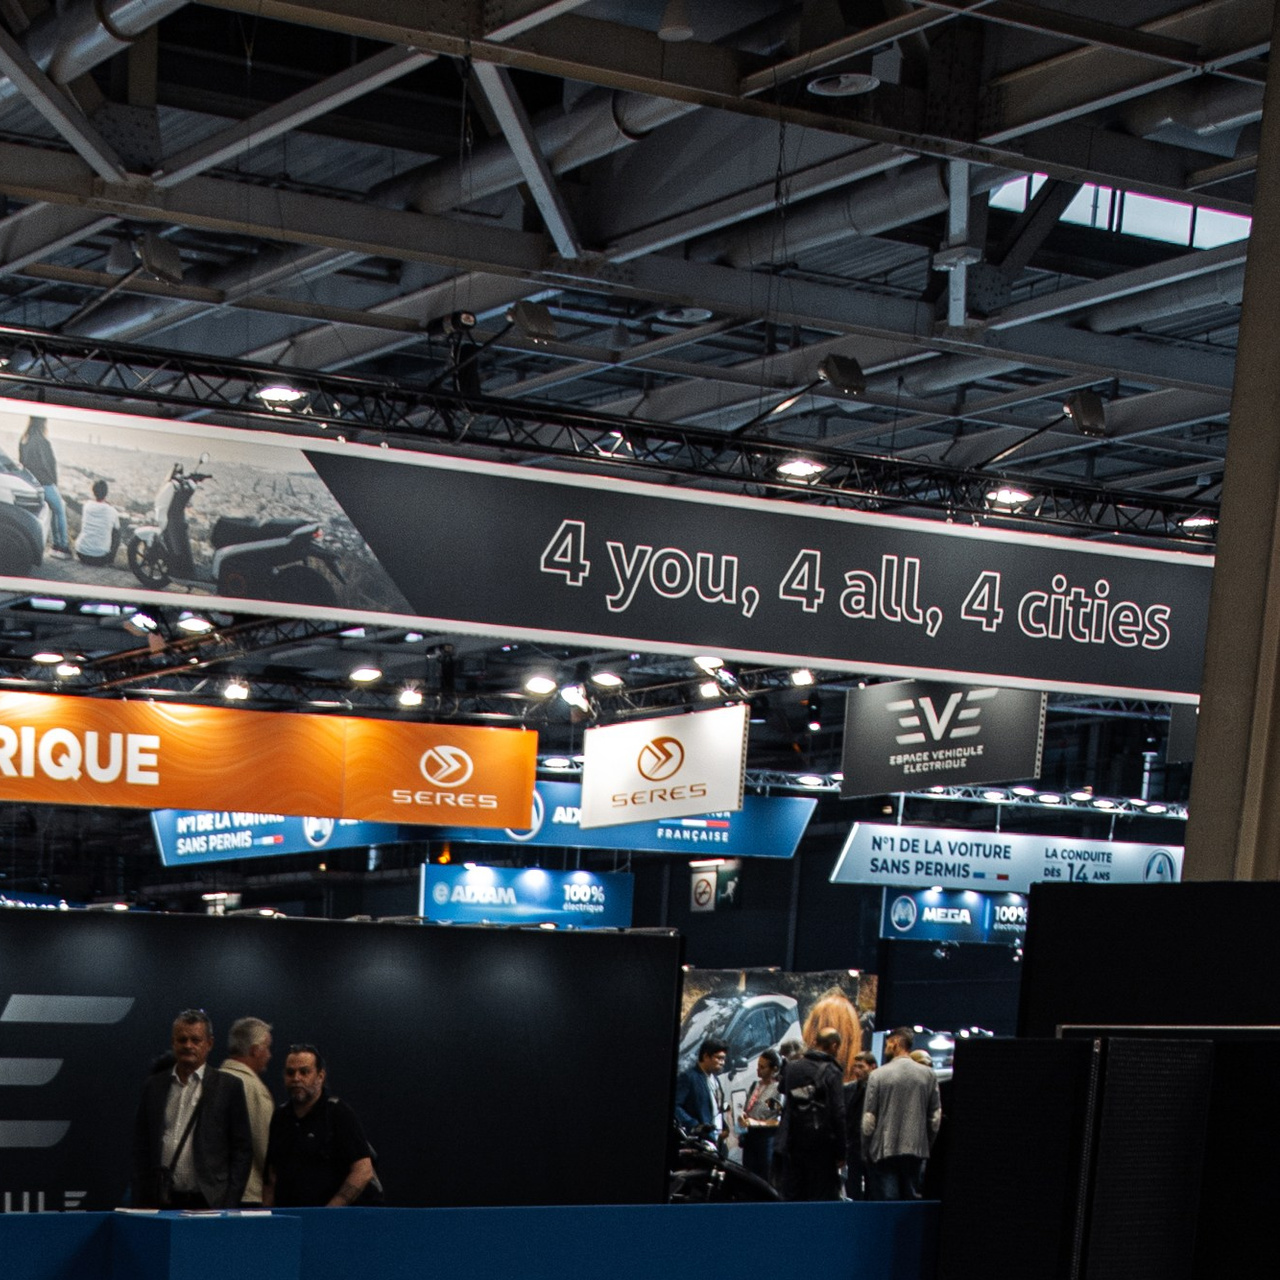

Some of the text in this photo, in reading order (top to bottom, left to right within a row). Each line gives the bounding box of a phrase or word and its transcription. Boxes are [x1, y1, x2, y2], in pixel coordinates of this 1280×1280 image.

[540, 520, 1171, 650] 4 you, 4 all, 4 cities
[886, 687, 999, 745] EVE
[889, 745, 984, 766] ESPACE VEHICULE
[903, 758, 967, 774] ELECTRIQUE
[391, 789, 498, 809] SERES
[612, 783, 707, 808] SERES
[552, 806, 581, 825] AIX
[176, 830, 253, 855] SANS PERMIS
[656, 828, 729, 843] FRANÇAISE
[899, 838, 920, 853] DE
[924, 839, 943, 855] LA
[947, 841, 1012, 860] VOITURE
[1045, 847, 1113, 863] LA CONDUITE
[870, 857, 970, 878] SANS PERMIS
[1043, 863, 1111, 882] DÈS 14 ANS
[563, 884, 605, 903] 100%
[562, 902, 605, 913] électrique
[922, 906, 971, 925] MEGA
